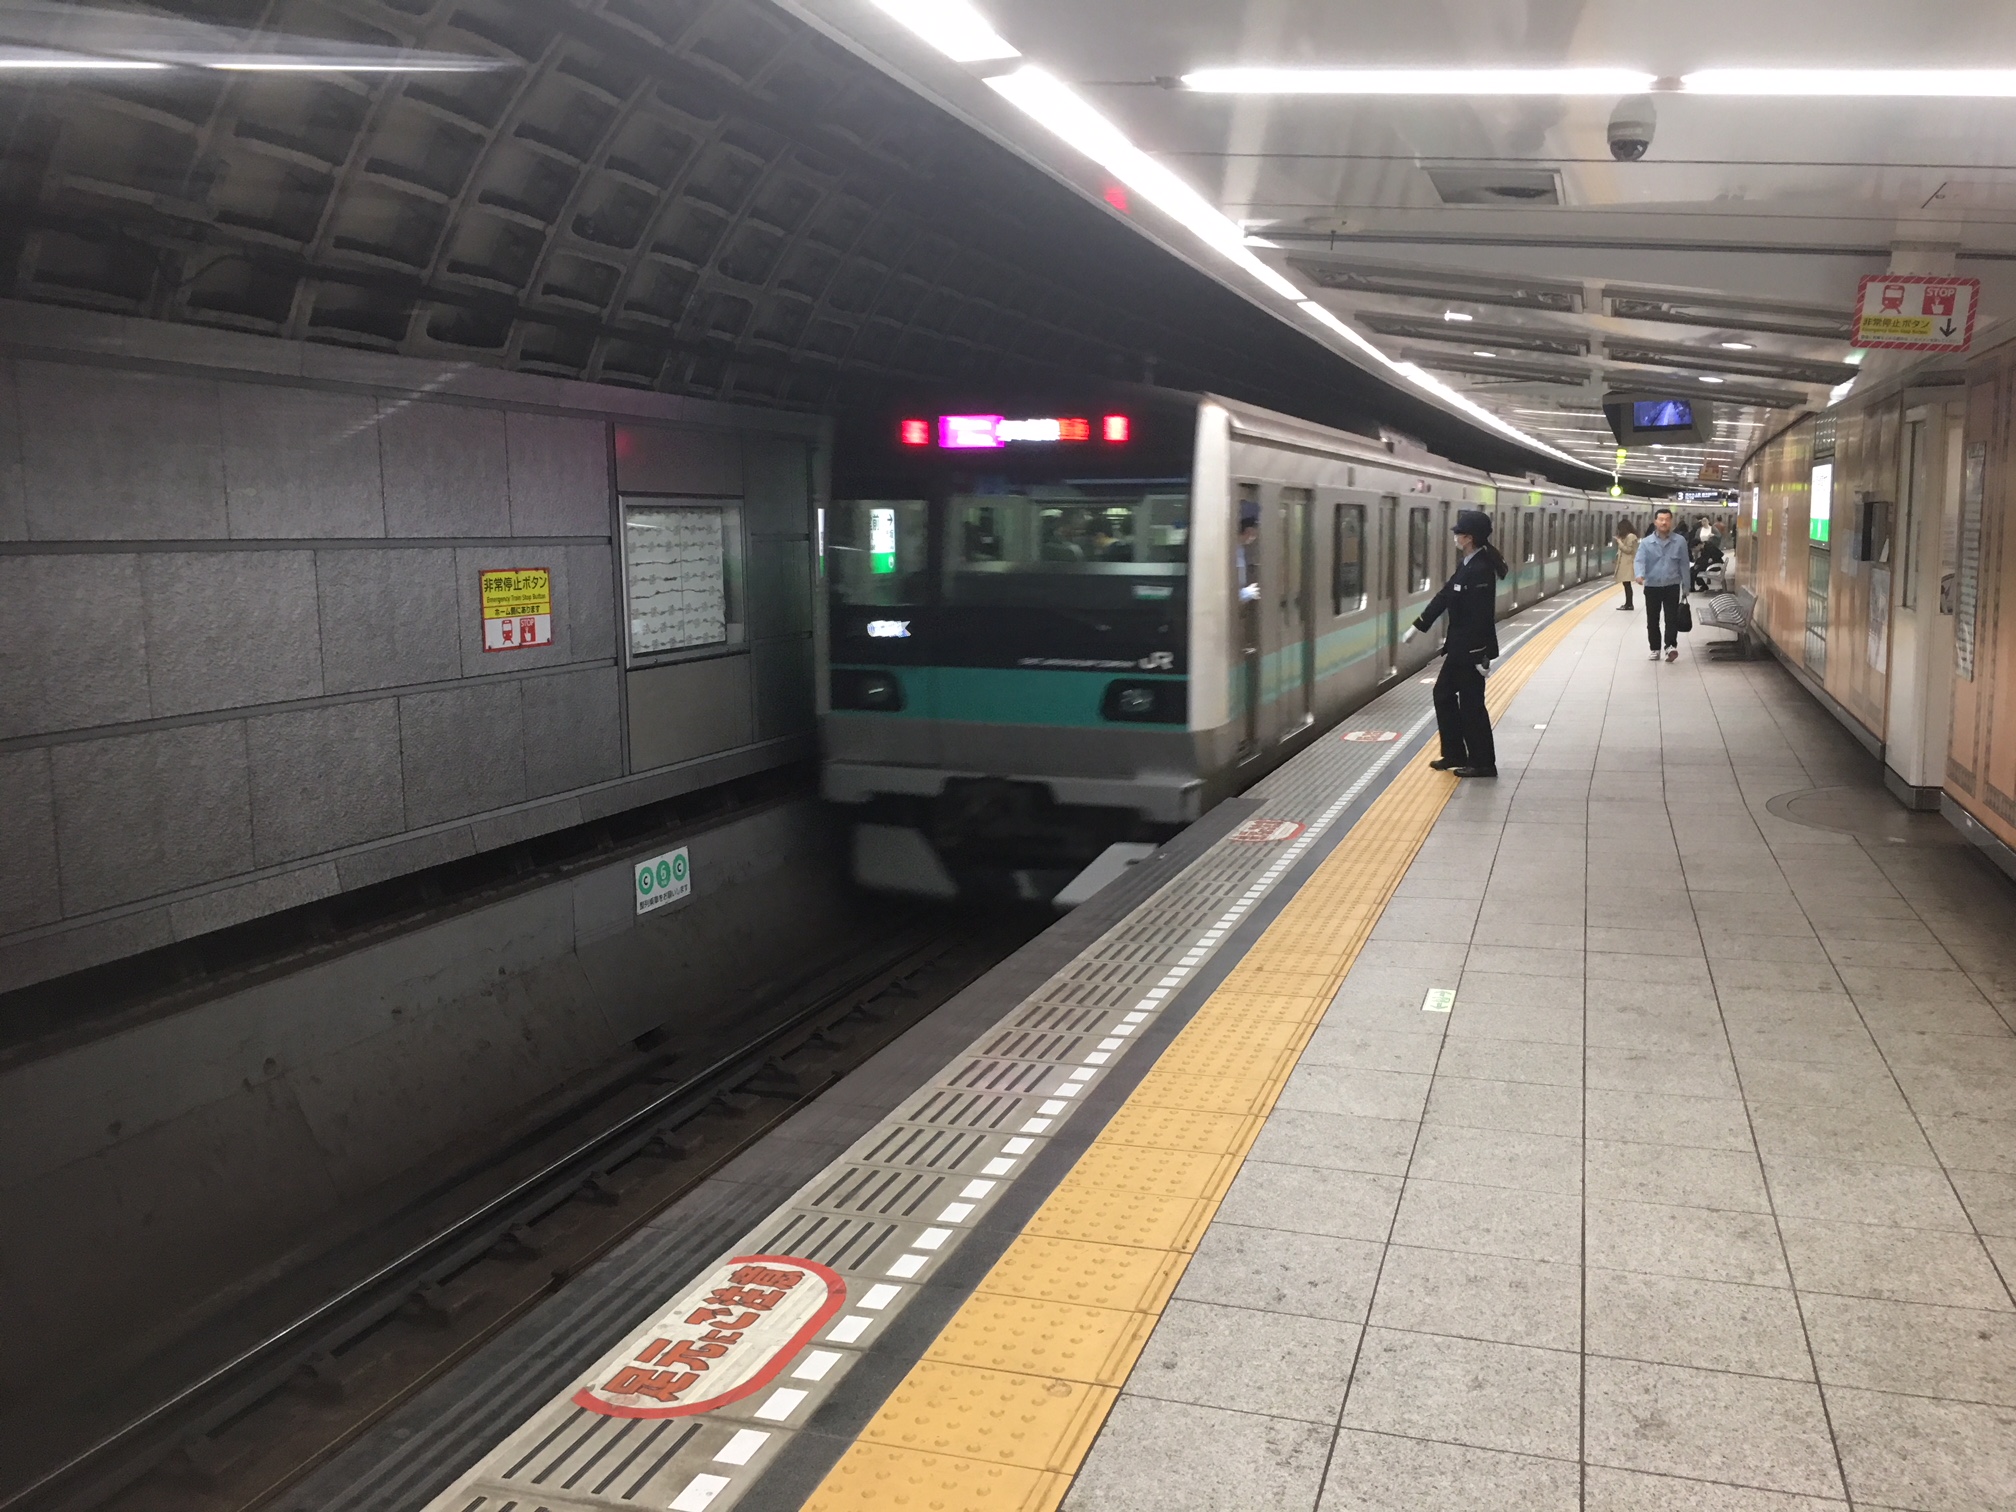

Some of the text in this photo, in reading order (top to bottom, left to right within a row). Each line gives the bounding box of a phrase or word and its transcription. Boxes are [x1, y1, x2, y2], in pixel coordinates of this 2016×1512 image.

[1926, 287, 1955, 297] STOP
[1862, 317, 1931, 328] 非常停止ボタン
[1677, 491, 1684, 500] 3
[483, 575, 547, 593] 非常停止ボタン
[487, 596, 511, 605] Emergency
[522, 594, 532, 602] Stop
[521, 618, 535, 627] STOP
[1138, 651, 1174, 670] JR
[600, 1265, 806, 1403] 足元にご注意
